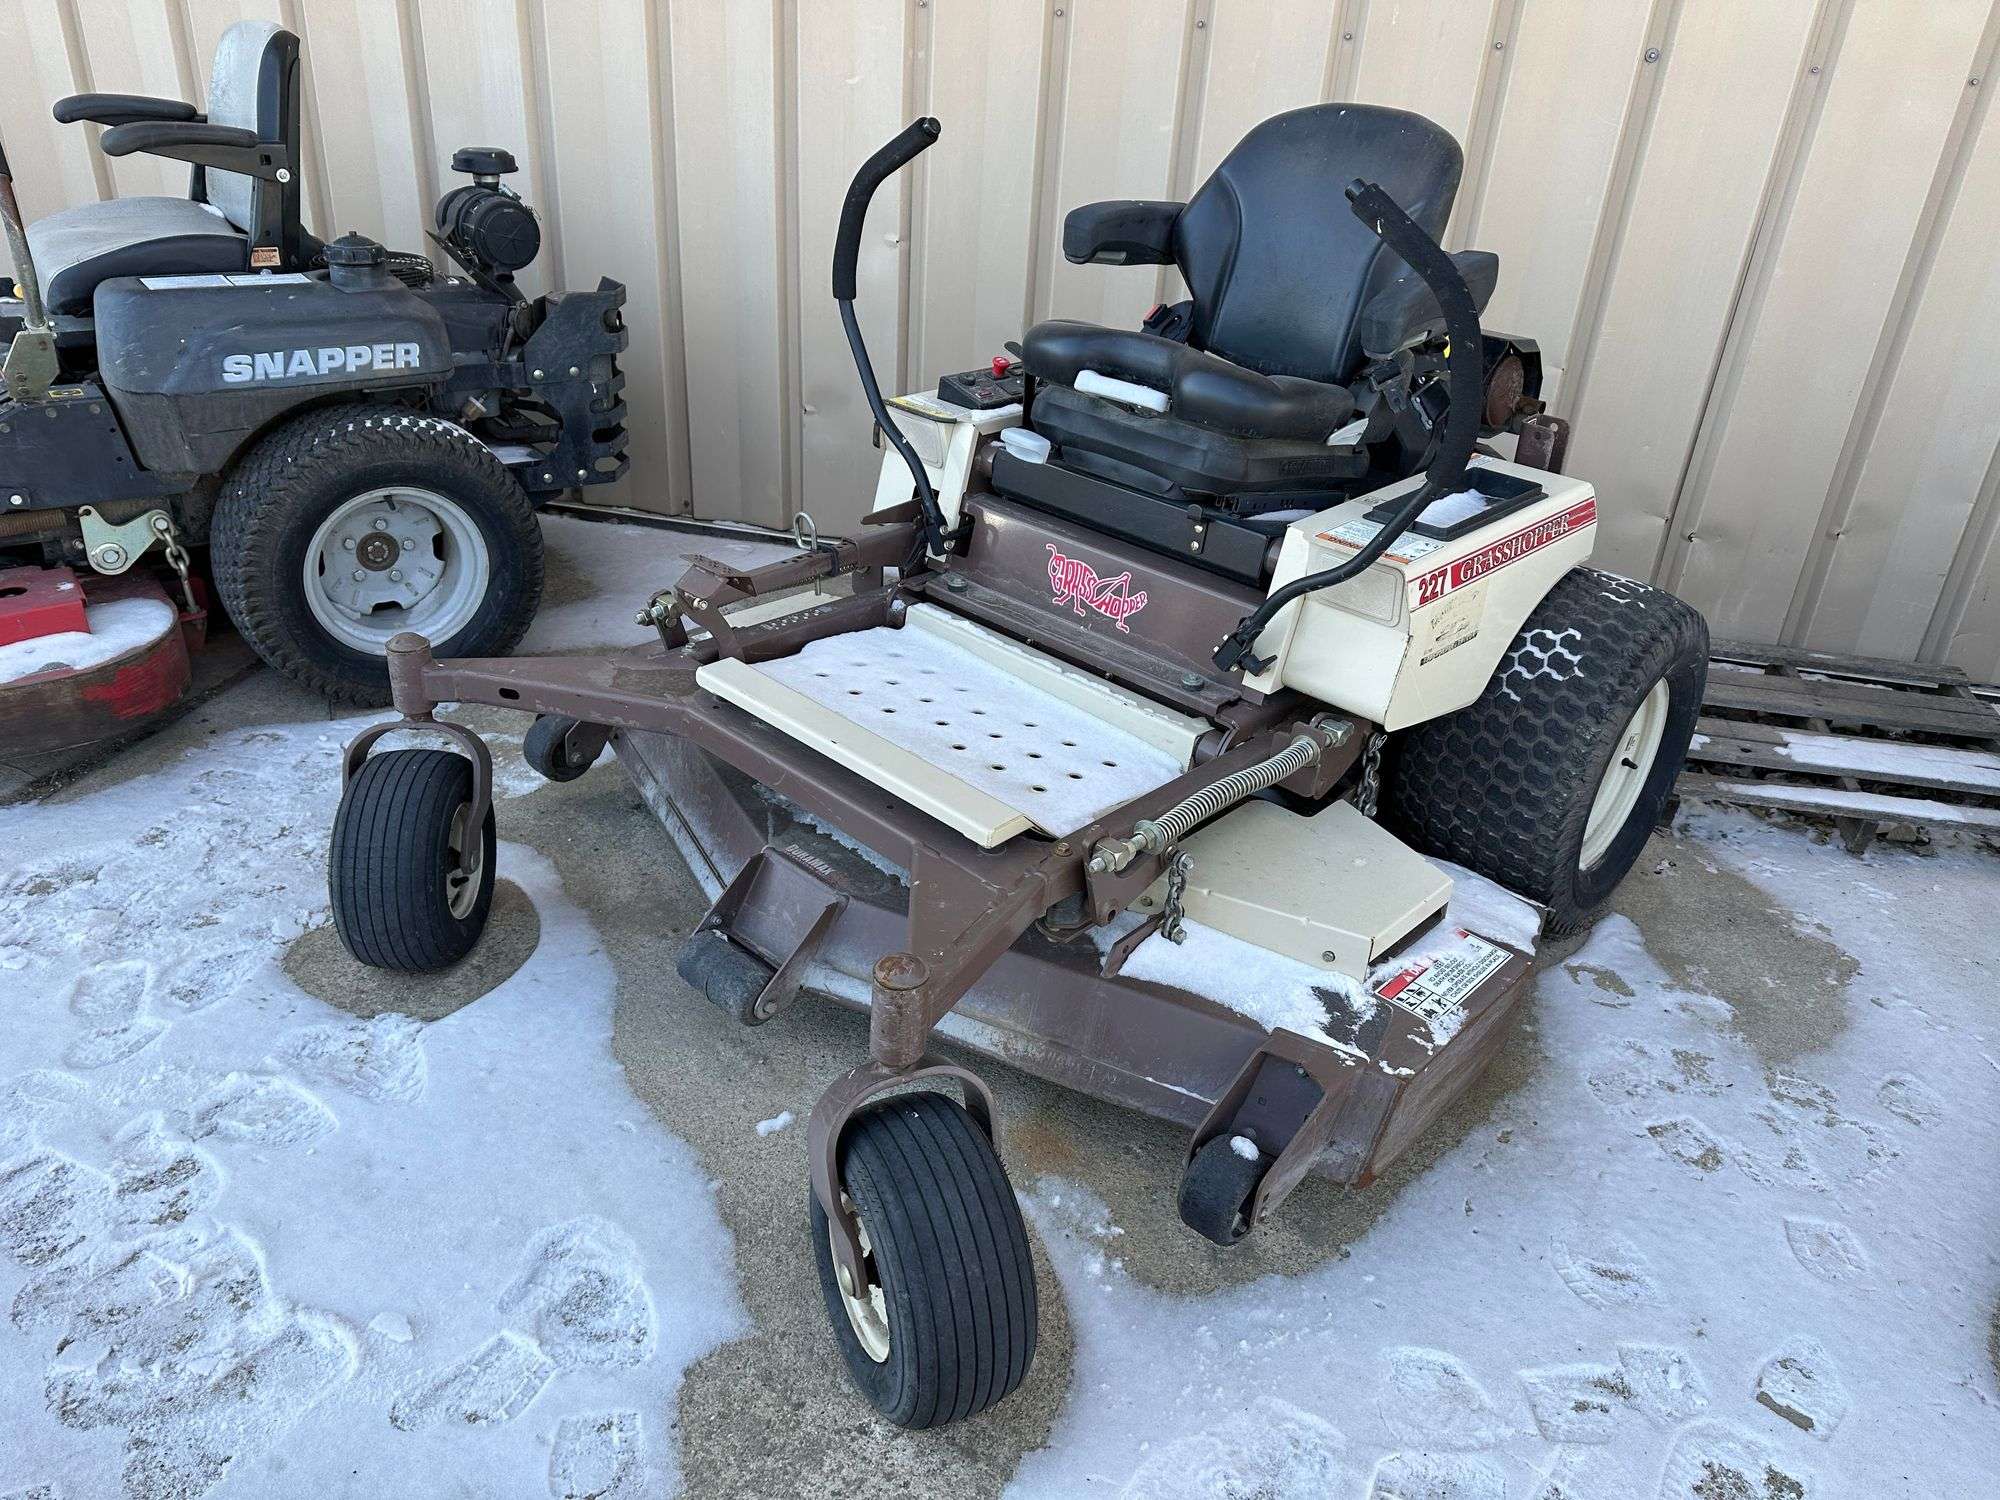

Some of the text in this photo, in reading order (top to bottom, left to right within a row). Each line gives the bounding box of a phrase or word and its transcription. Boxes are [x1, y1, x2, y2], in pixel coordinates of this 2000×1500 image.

[222, 342, 420, 383] SNAPPER
[1047, 549, 1148, 630] GRASSHOPPER
[1418, 567, 1448, 606] 227
[1459, 513, 1571, 582] GRASSHOPPER
